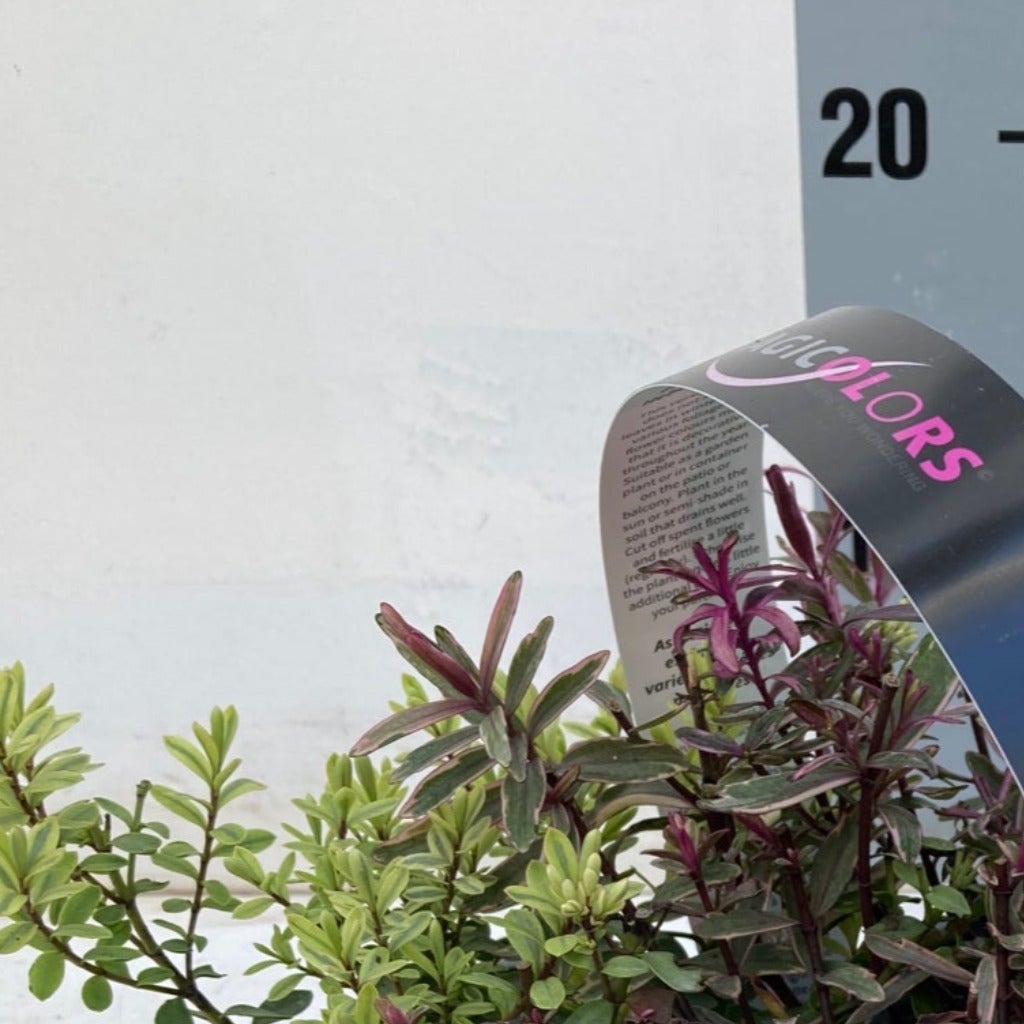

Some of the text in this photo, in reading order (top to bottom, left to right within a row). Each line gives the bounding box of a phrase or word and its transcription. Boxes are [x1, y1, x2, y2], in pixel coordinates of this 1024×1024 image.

[821, 87, 929, 180] 20
[705, 431, 749, 456] garden
[623, 442, 748, 499] plant or in container
[640, 460, 731, 501] on the patio or
[713, 475, 725, 486] in
[727, 466, 748, 480] the
[623, 518, 646, 532] sun
[647, 512, 661, 523] or
[736, 479, 749, 490] in
[625, 527, 648, 543] soil
[650, 518, 675, 535] that
[678, 503, 716, 524] drains
[625, 542, 646, 557] Cut
[649, 534, 667, 549] off
[668, 522, 703, 542] spent
[706, 505, 750, 527] flowers
[633, 552, 656, 568] and
[623, 585, 644, 600] the
